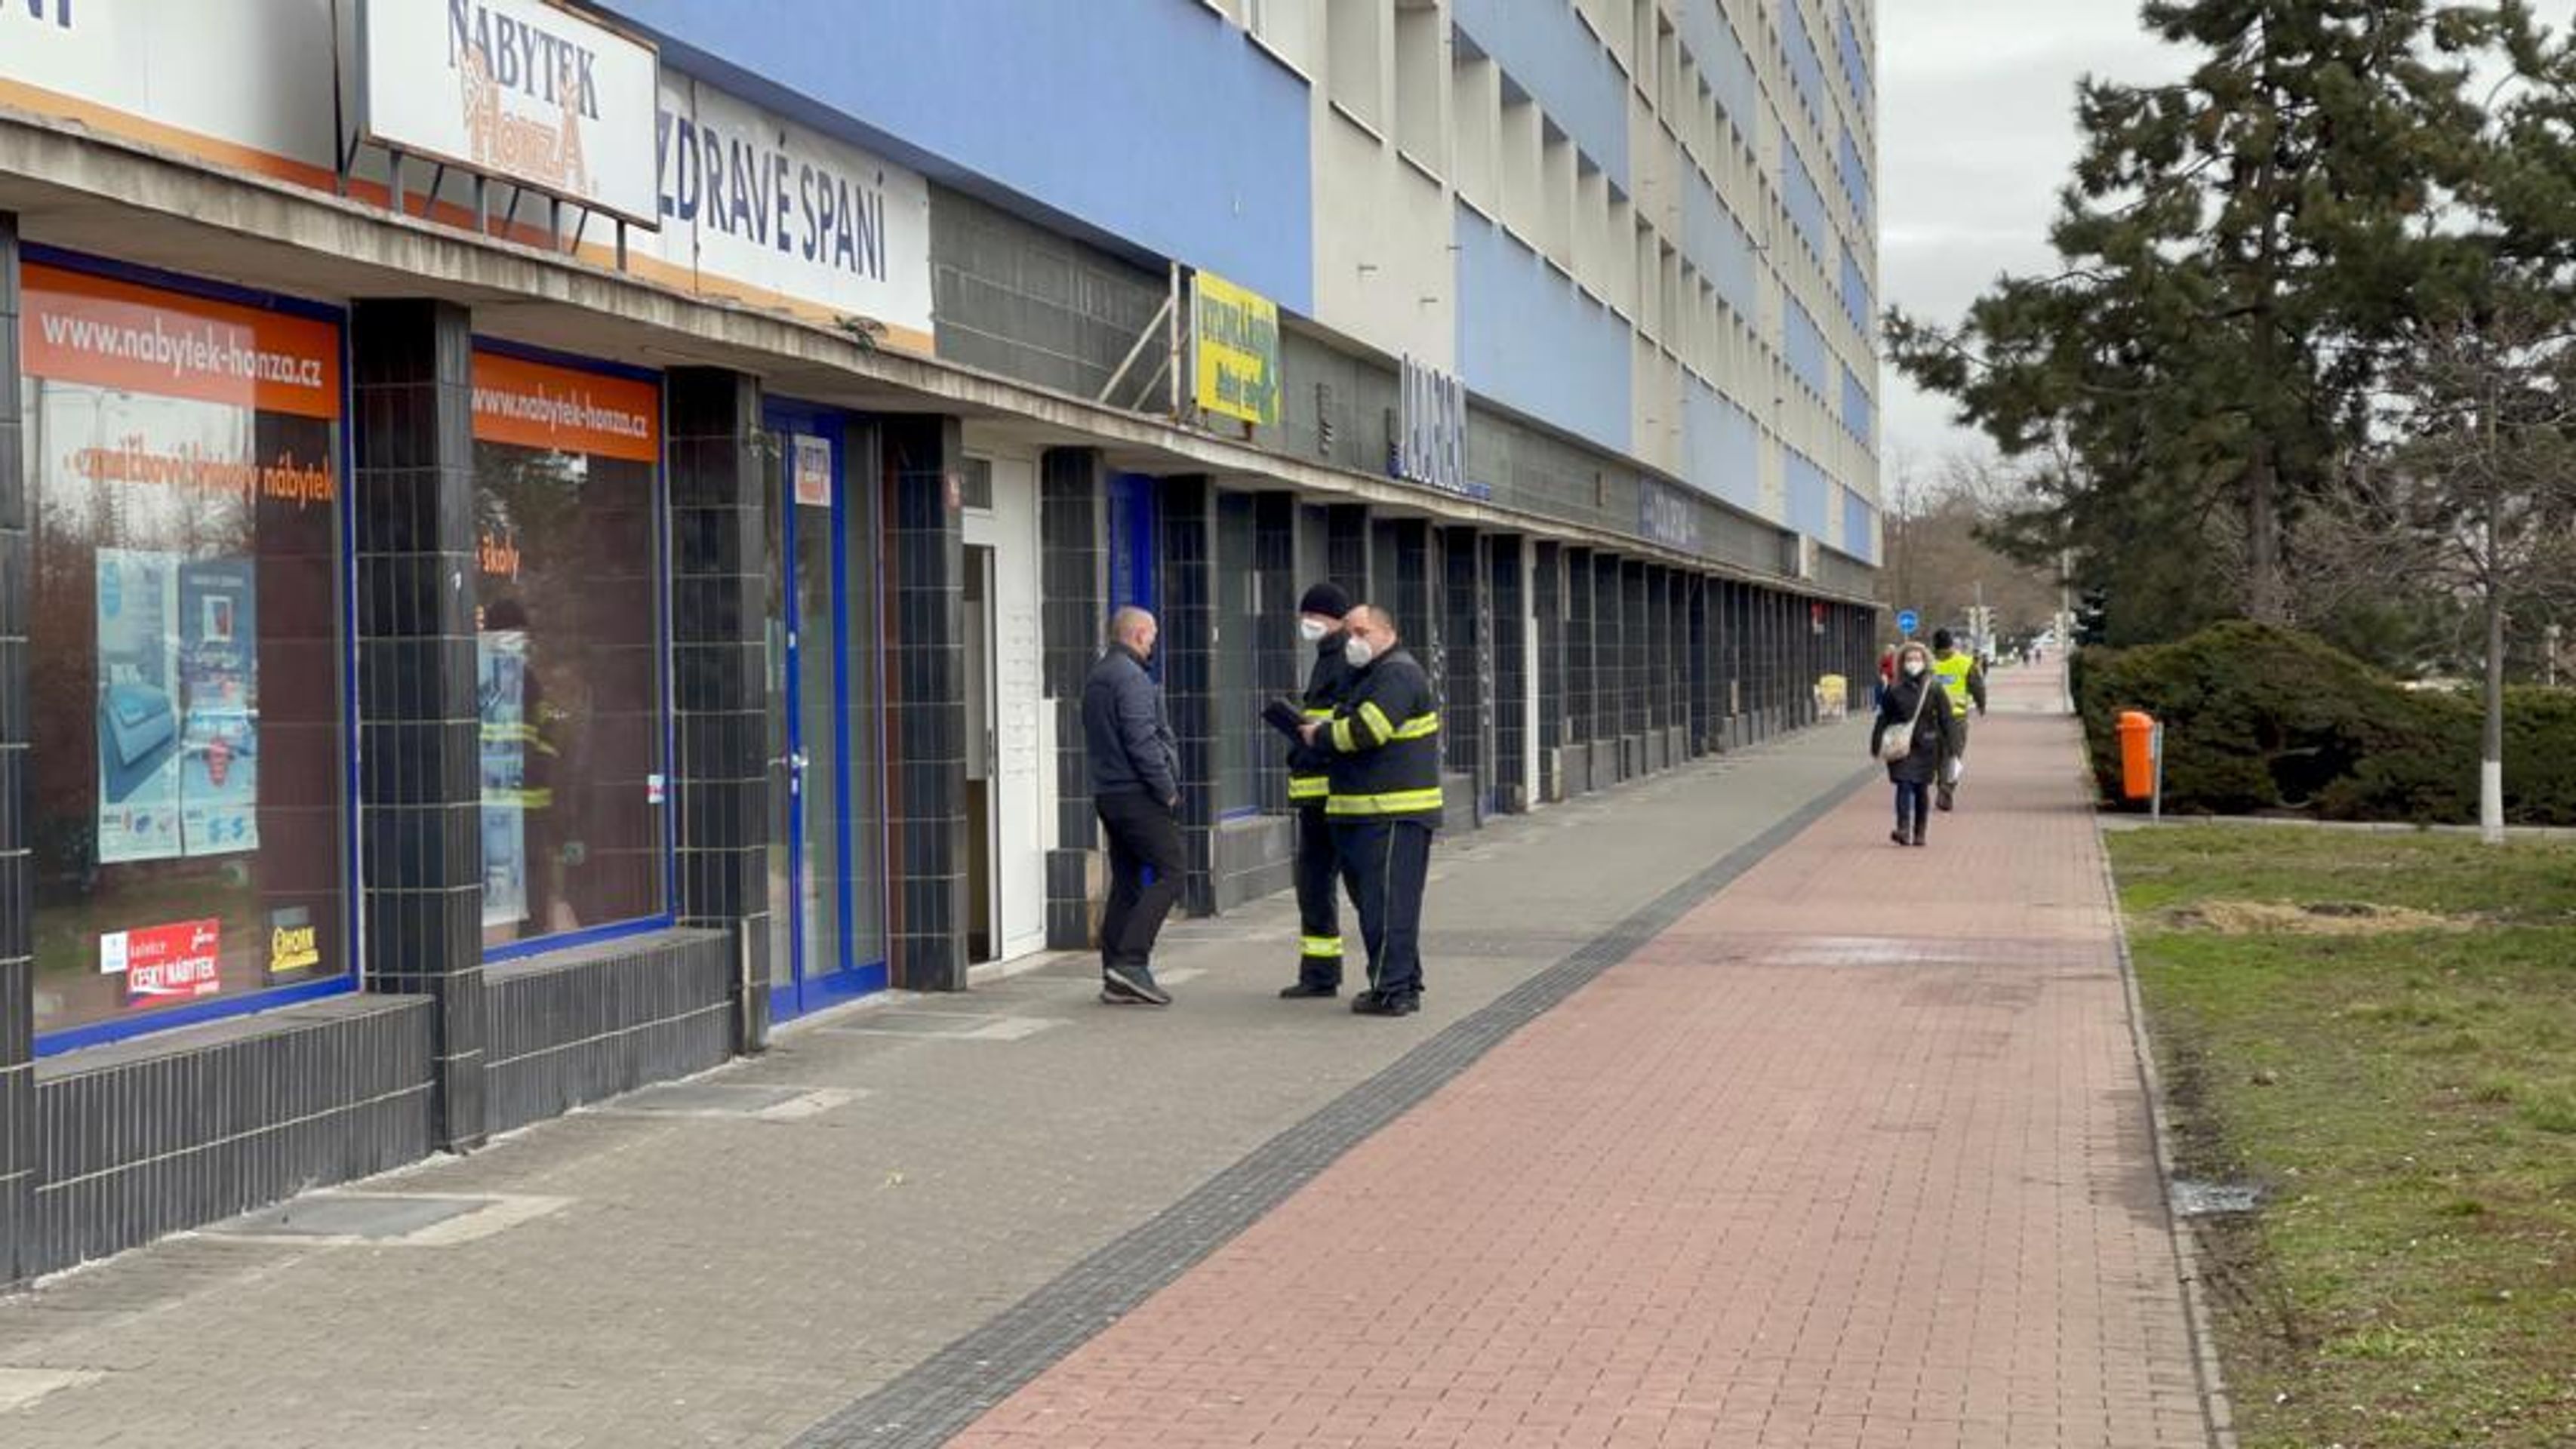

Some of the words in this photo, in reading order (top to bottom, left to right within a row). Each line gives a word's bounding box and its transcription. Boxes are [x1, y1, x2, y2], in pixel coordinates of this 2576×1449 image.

[448, 0, 600, 121] NABYTEK
[799, 163, 886, 283] SPANÍ
[41, 311, 323, 387] www.nabytek-honza.cz
[471, 382, 648, 438] www.nabytek-honza.cz
[264, 451, 334, 511] nábytek
